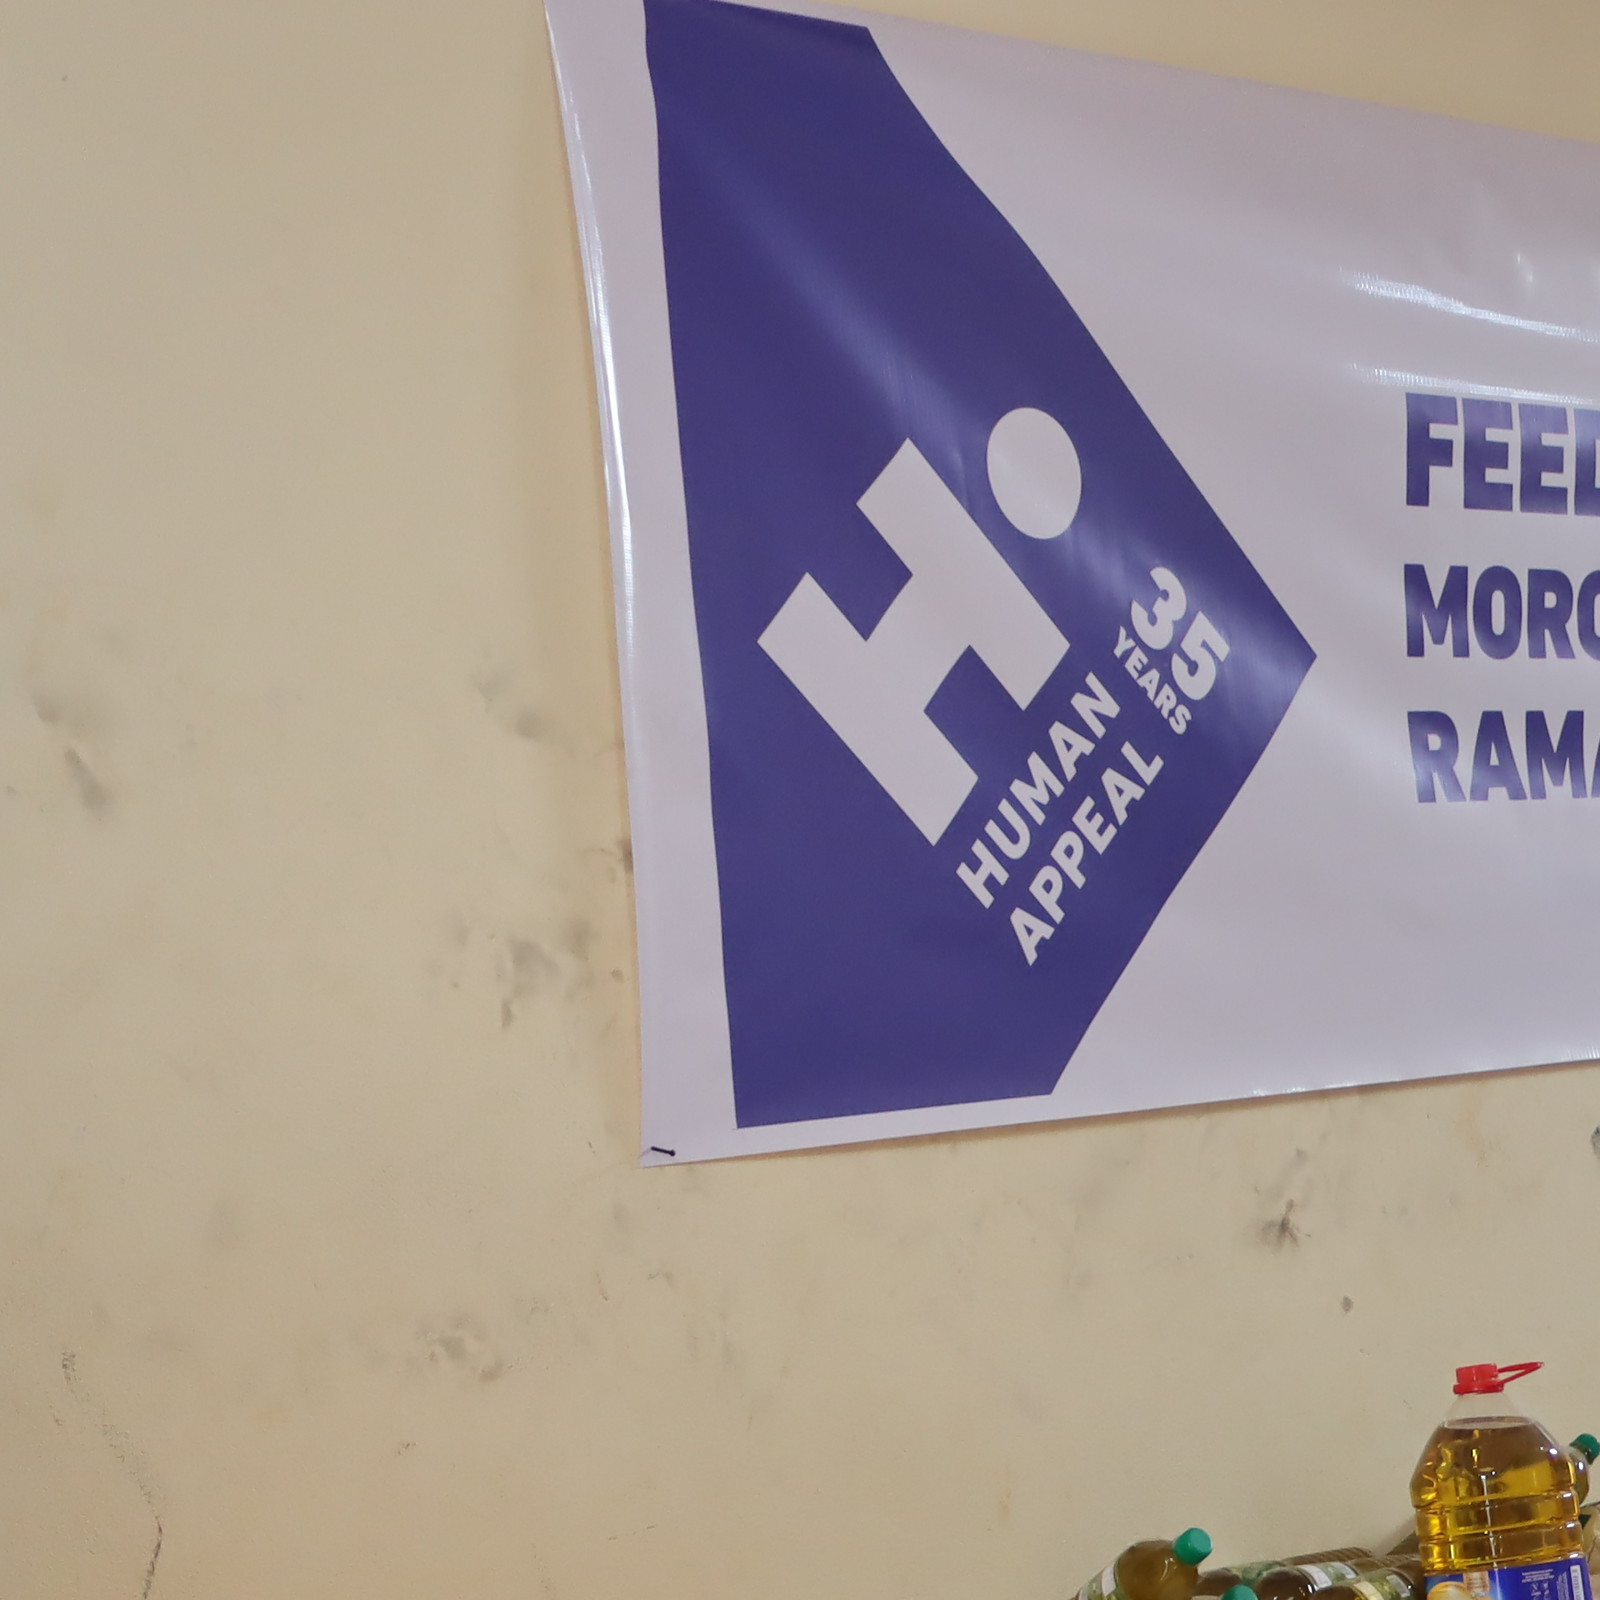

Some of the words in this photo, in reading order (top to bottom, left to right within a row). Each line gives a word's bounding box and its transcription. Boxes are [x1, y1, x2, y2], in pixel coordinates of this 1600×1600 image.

[1113, 625, 1192, 735] YEARS
[1131, 566, 1231, 700] 35
[955, 670, 1121, 910] HUMAN
[1009, 741, 1164, 966] APPEAL
